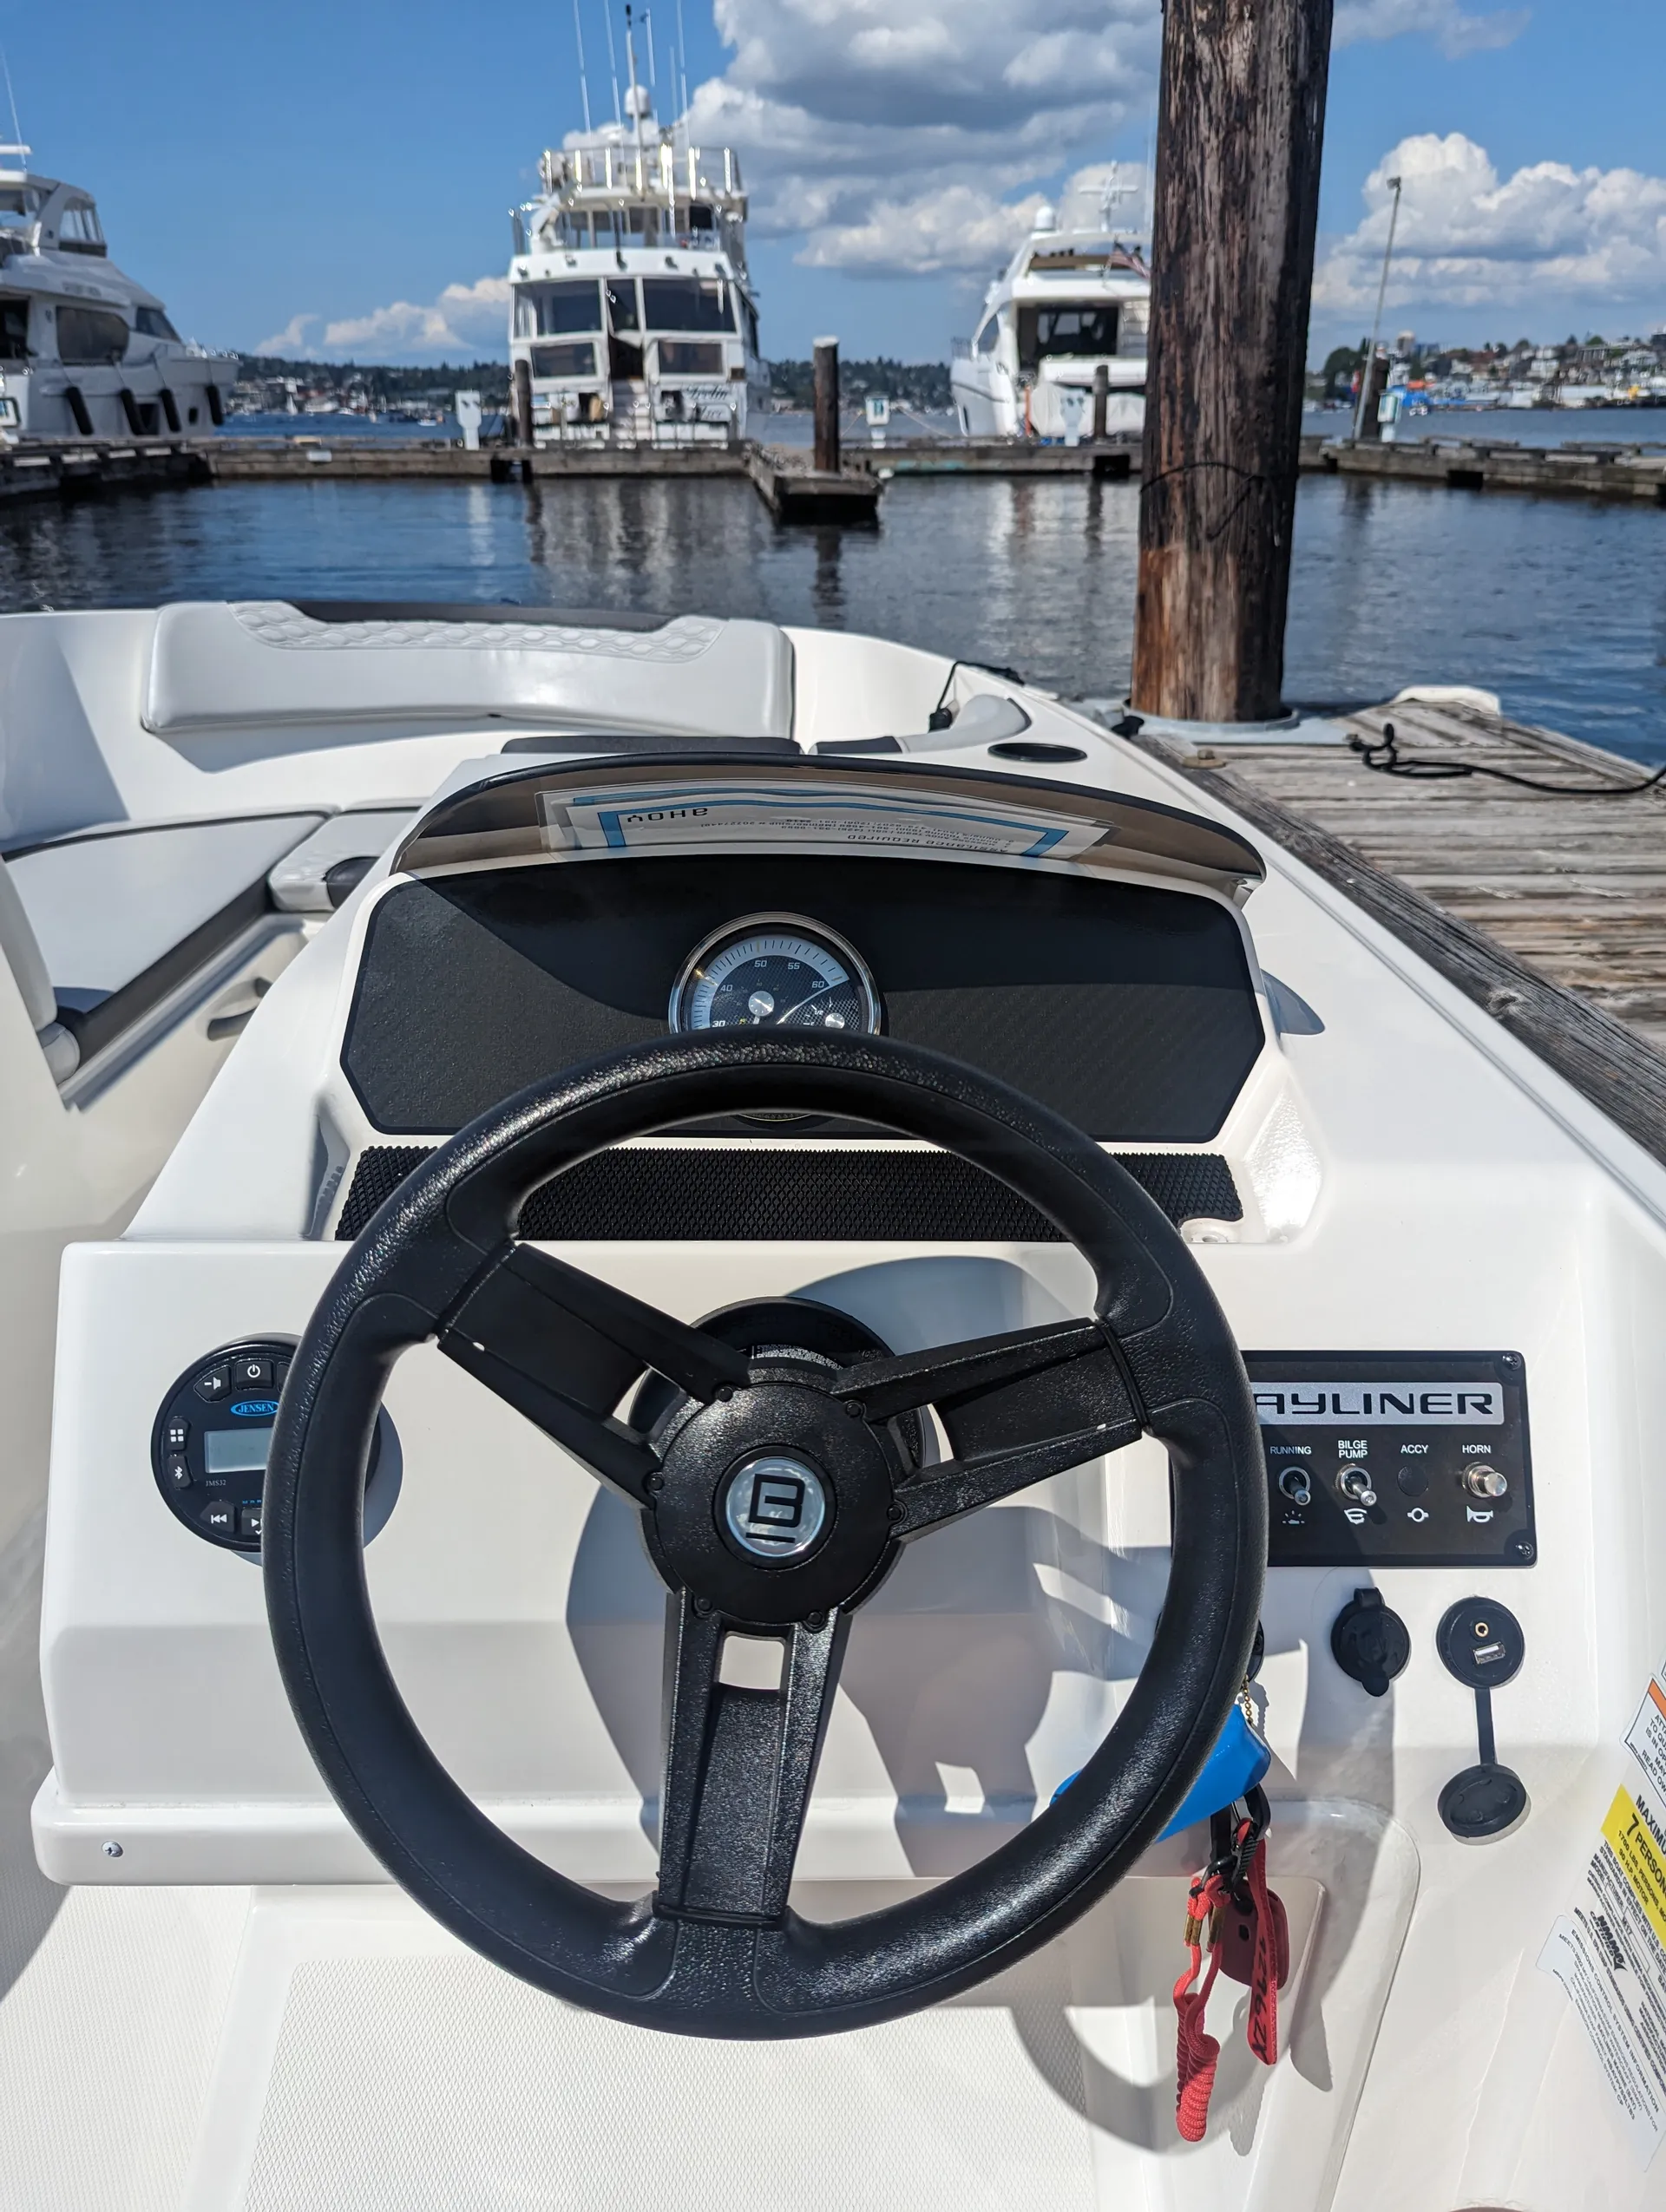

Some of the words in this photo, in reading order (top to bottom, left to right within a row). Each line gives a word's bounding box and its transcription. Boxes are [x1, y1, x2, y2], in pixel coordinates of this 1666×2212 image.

[754, 959, 767, 968] 50
[720, 984, 733, 992] 40
[811, 980, 825, 989] 60
[238, 1404, 275, 1413] JENSEN
[1253, 1393, 1493, 1415] AYLINER
[1269, 1445, 1312, 1456] RUNNING
[1338, 1440, 1368, 1450] BILGE
[1338, 1449, 1368, 1458] PUMP
[1400, 1444, 1428, 1454] ACCY
[1462, 1444, 1492, 1454] HORN
[1650, 1718, 1658, 1733] TO
[1655, 1714, 1666, 1735] ATT
[1645, 1727, 1652, 1738] IS
[1651, 1737, 1659, 1749] IN
[1642, 1750, 1657, 1776] READ
[1657, 1776, 1666, 1794] OW
[1617, 1829, 1630, 1851] 1700
[1629, 1850, 1639, 1870] LBS.
[1627, 1812, 1639, 1836] 7
[1635, 1831, 1666, 1896] PERSON
[1604, 1840, 1613, 1858] THIS
[1611, 1856, 1623, 1876] BOAT
[1622, 1876, 1643, 1914] COMPLIES
[1641, 1912, 1652, 1934] WITH
[1618, 1848, 1625, 1860] 90
[1633, 1875, 1650, 1905] MOTOR
[1599, 1846, 1623, 1888] STANDARDS
[1622, 1888, 1627, 1897] IN
[1626, 1896, 1642, 1924] EFFECT
[1640, 1924, 1647, 1937] ON
[1646, 1935, 1656, 1953] THE
[1558, 1934, 1576, 1953] MEETS
[1590, 1910, 1614, 1956] CERTIFIED
[1571, 1928, 1594, 1972] EMISSIONS
[1593, 1973, 1612, 2013] CONTROL
[1612, 2013, 1630, 2049] SYSTEM
[1629, 2049, 1659, 2112] INFORMATION
[1638, 2007, 1665, 2063] MANUFACTUR
